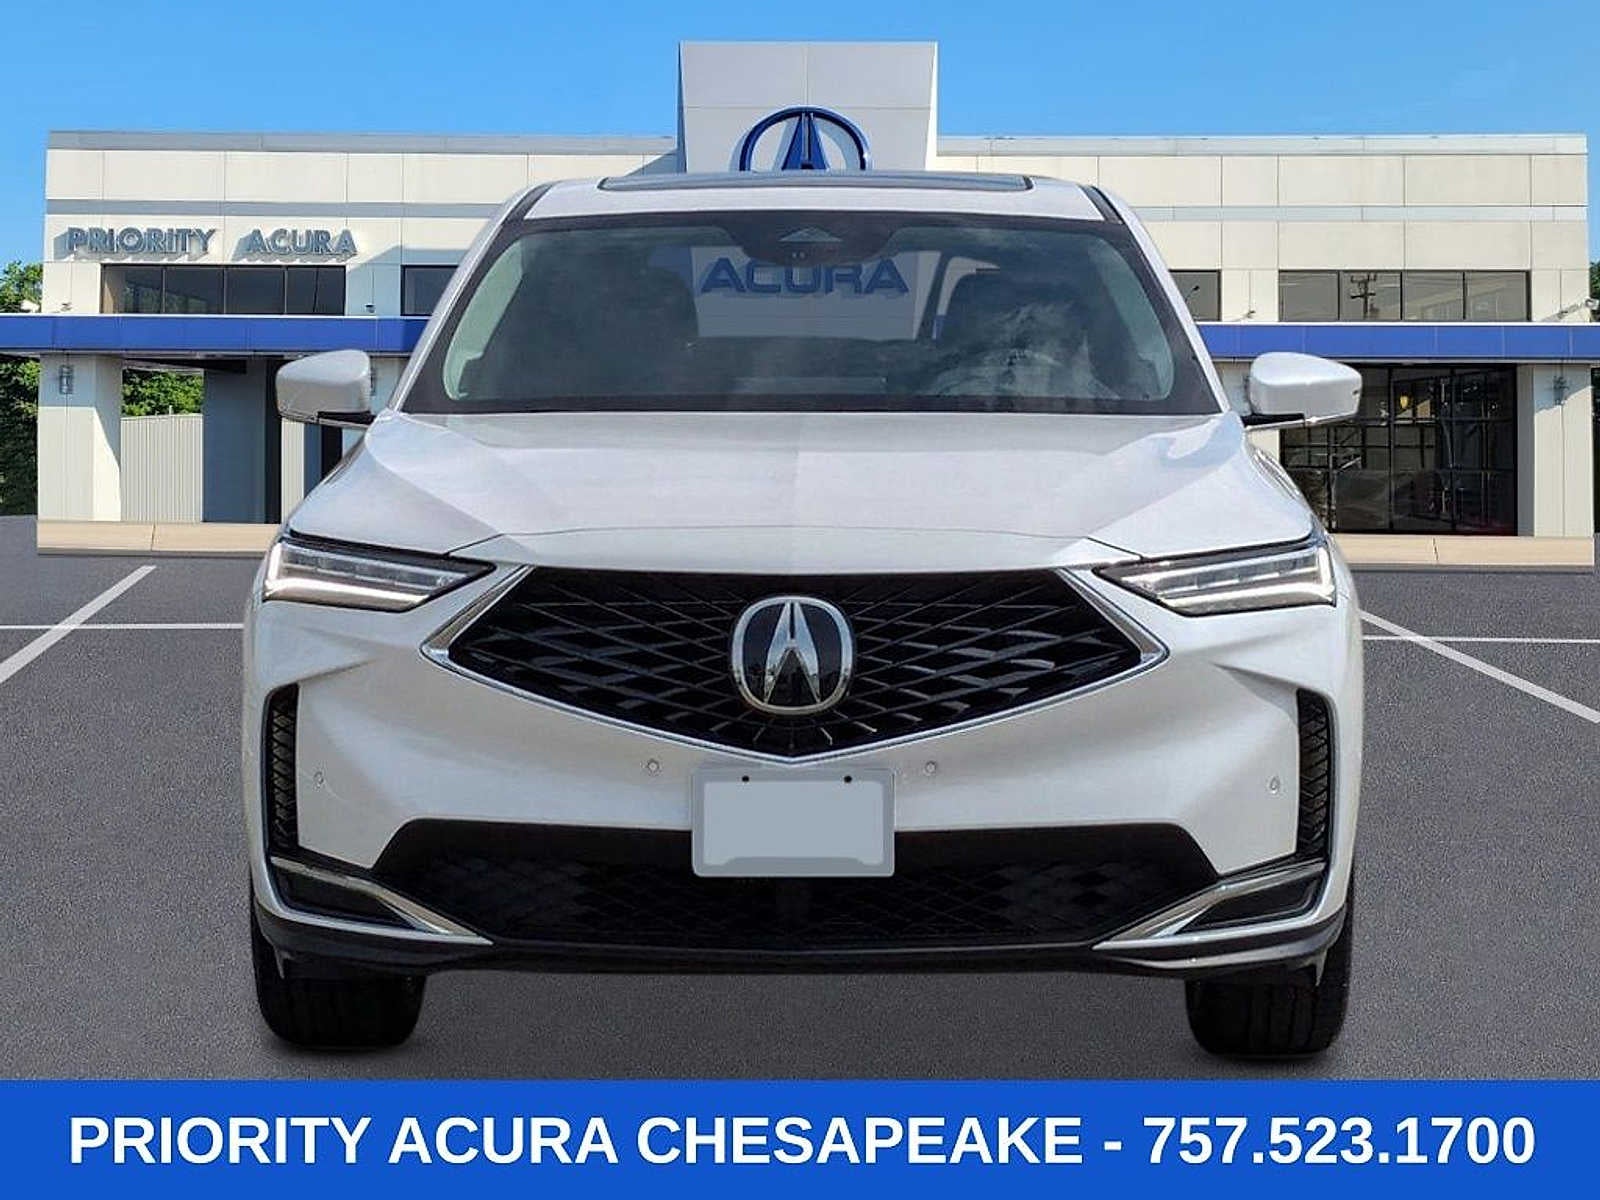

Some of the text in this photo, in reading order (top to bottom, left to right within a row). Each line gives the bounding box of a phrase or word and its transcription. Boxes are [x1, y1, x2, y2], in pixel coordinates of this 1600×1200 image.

[66, 226, 357, 255] PRIORITY ACURA
[701, 257, 908, 294] ACURA
